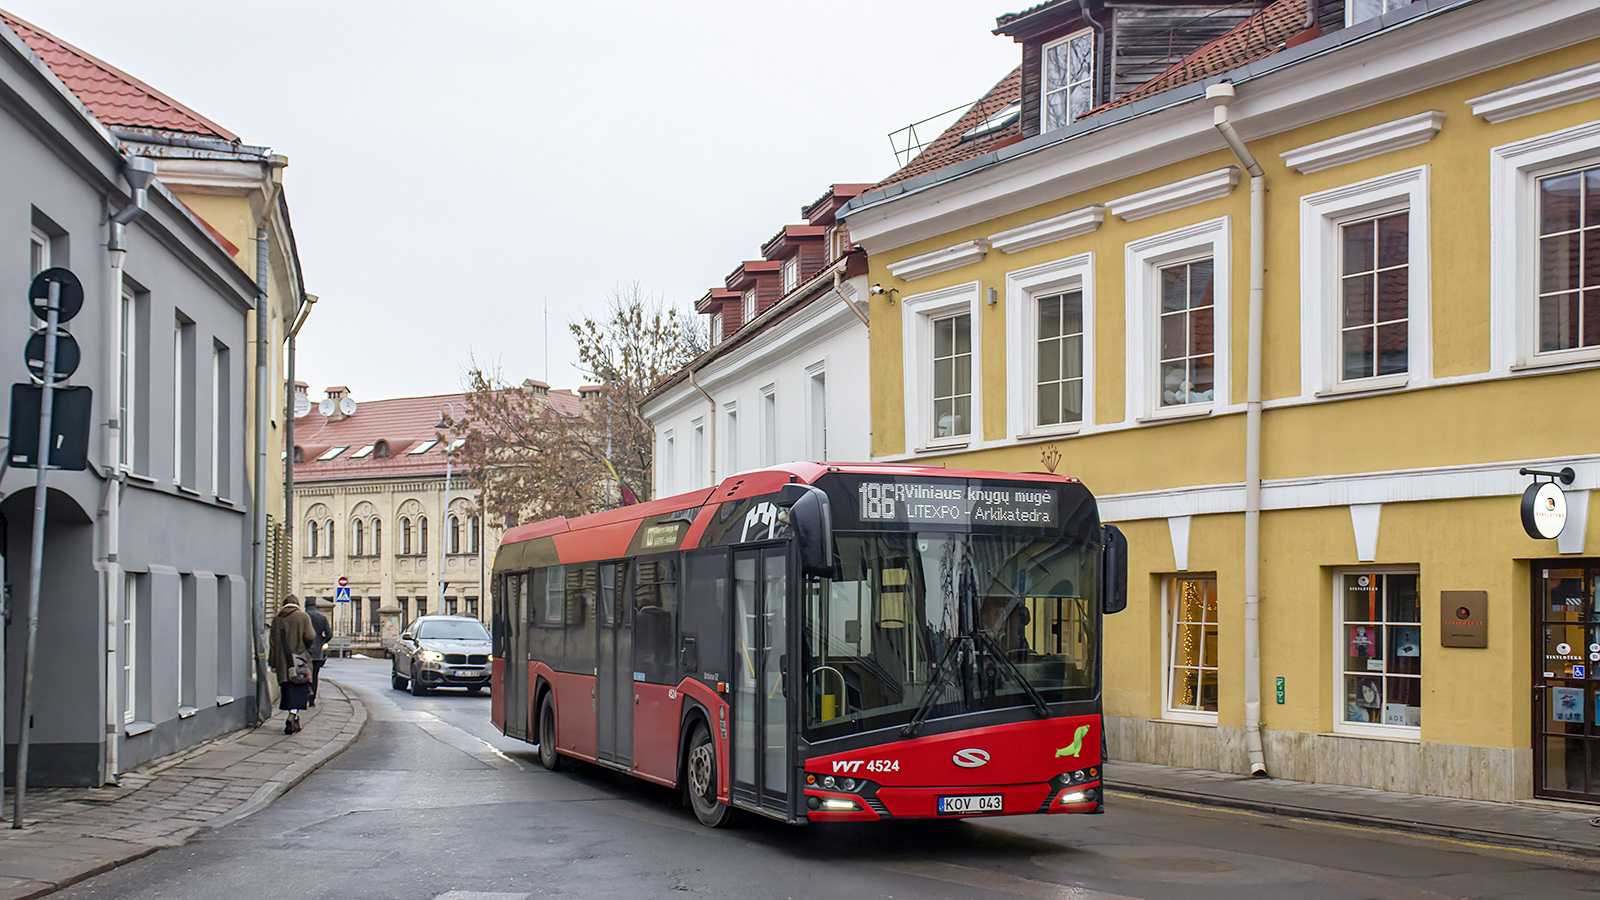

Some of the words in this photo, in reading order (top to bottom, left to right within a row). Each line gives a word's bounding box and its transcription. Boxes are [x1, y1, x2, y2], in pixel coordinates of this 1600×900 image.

[905, 485, 962, 500] Vilniaus
[967, 486, 1010, 505] knygų
[1014, 489, 1052, 506] mugė
[907, 504, 960, 519] LITEXPO
[975, 506, 1051, 522] Arkikatedra
[832, 760, 865, 773] VVT
[866, 759, 900, 772] 4524
[945, 798, 971, 810] KOV
[979, 797, 1001, 809] 043
